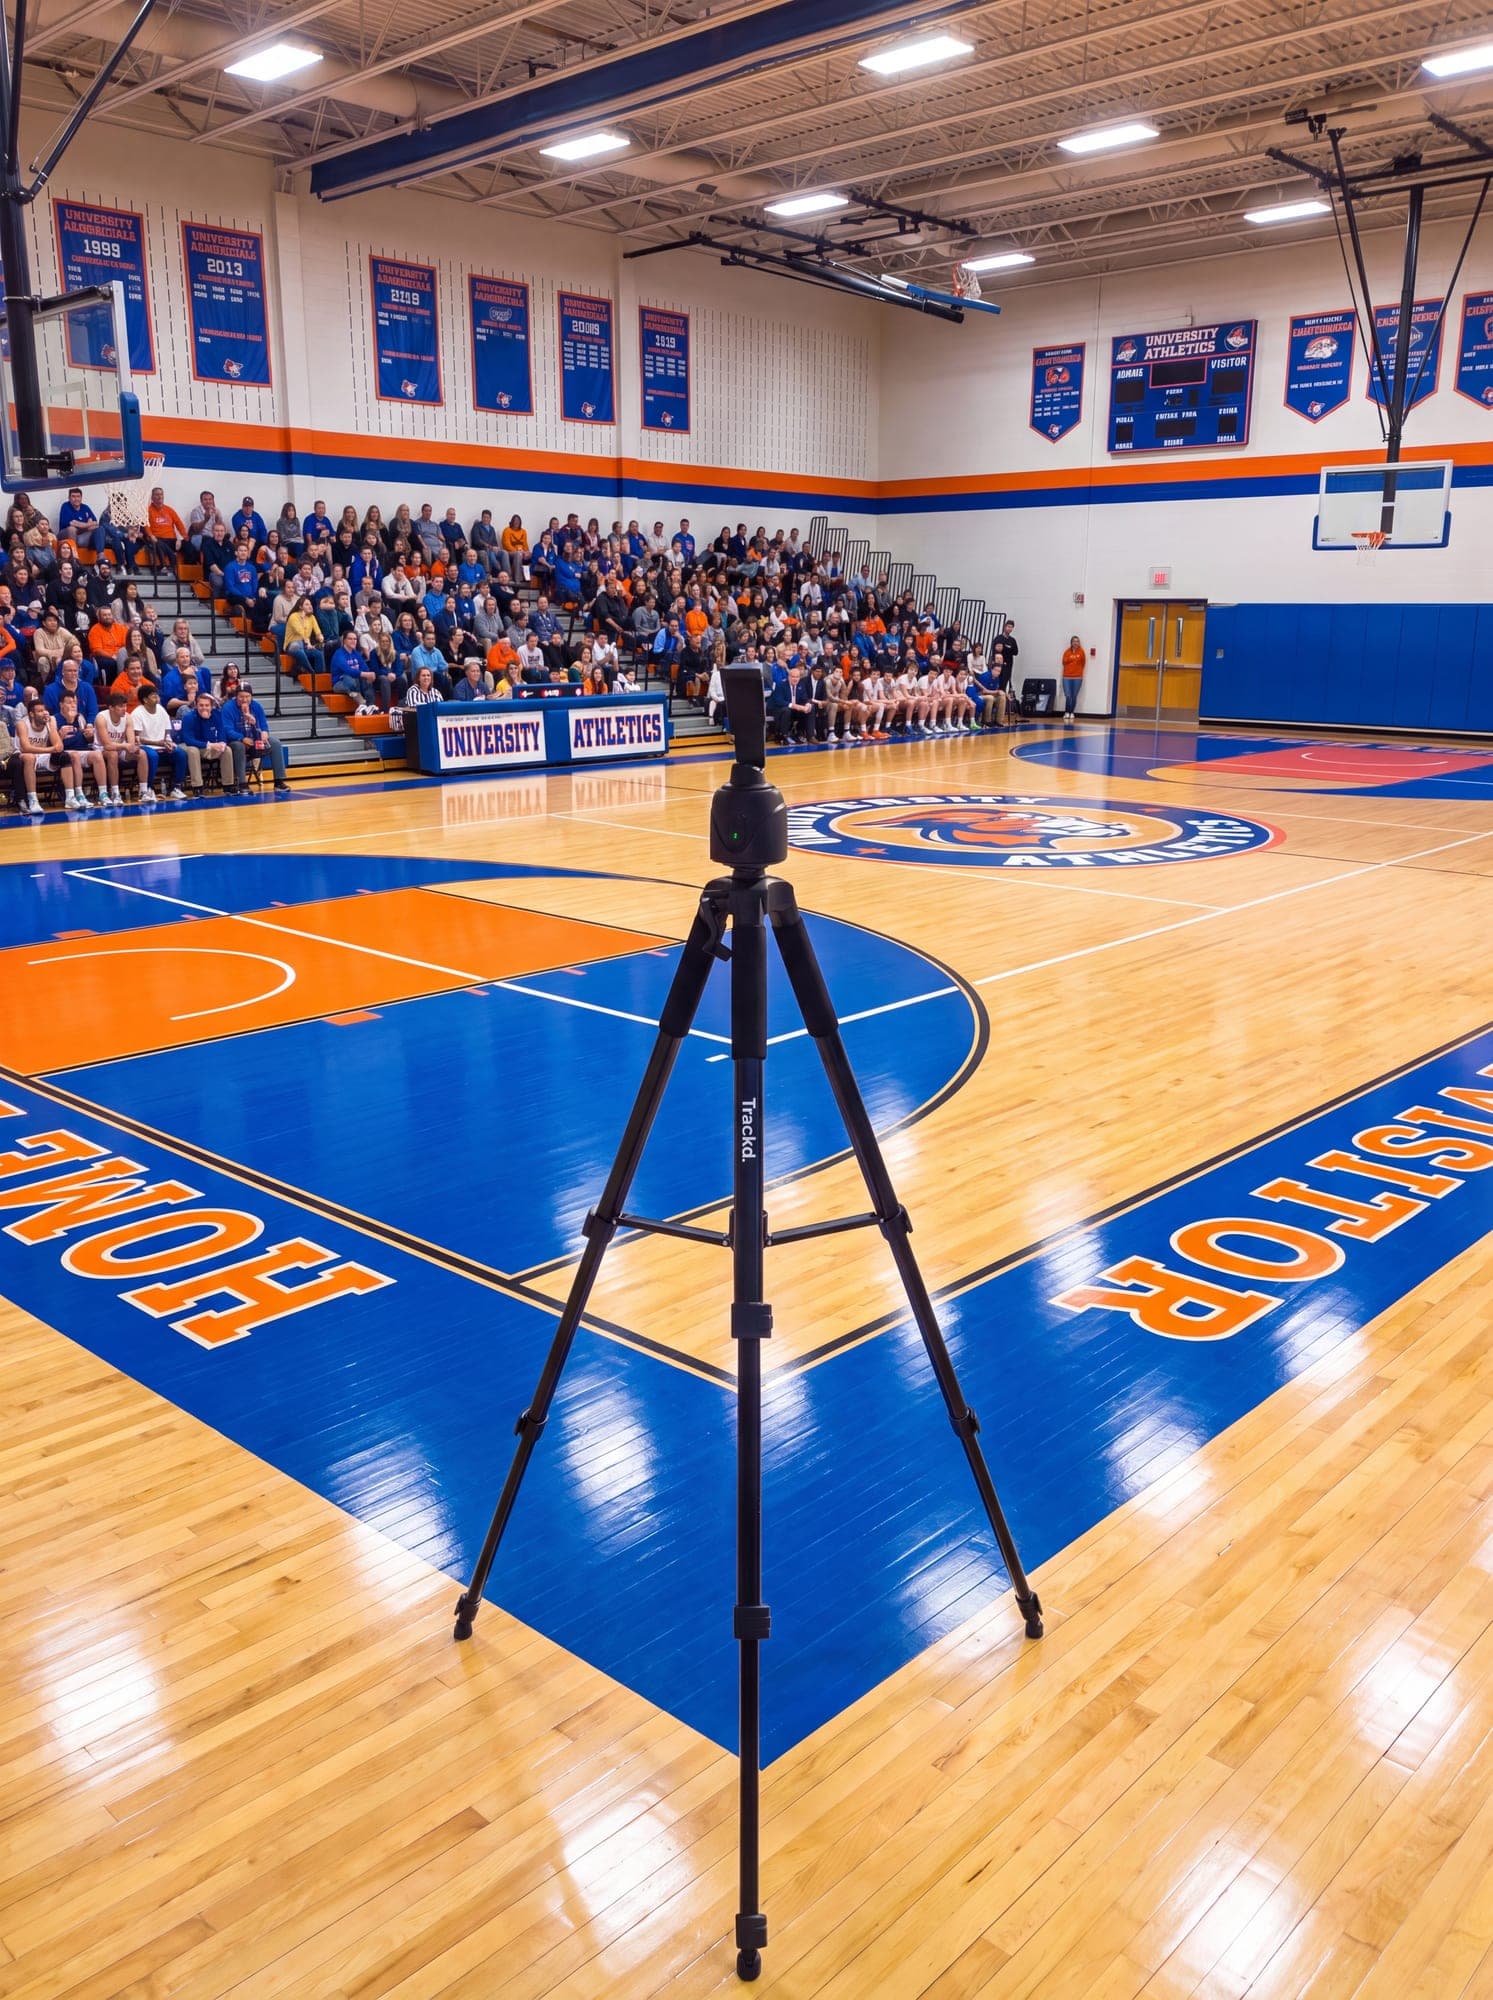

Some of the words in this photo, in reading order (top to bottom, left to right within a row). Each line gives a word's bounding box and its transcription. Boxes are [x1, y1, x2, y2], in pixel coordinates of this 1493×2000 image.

[207, 258, 243, 276] 2013
[1143, 341, 1216, 360] ATHLETICS
[1145, 327, 1219, 347] UNIVERSITY
[1211, 356, 1247, 369] VISITOR
[441, 721, 540, 758] UNIVERSITY
[573, 713, 662, 748] ATHLETICS
[1002, 818, 1255, 866] ATHLETICS
[741, 1097, 757, 1163] Trackd.
